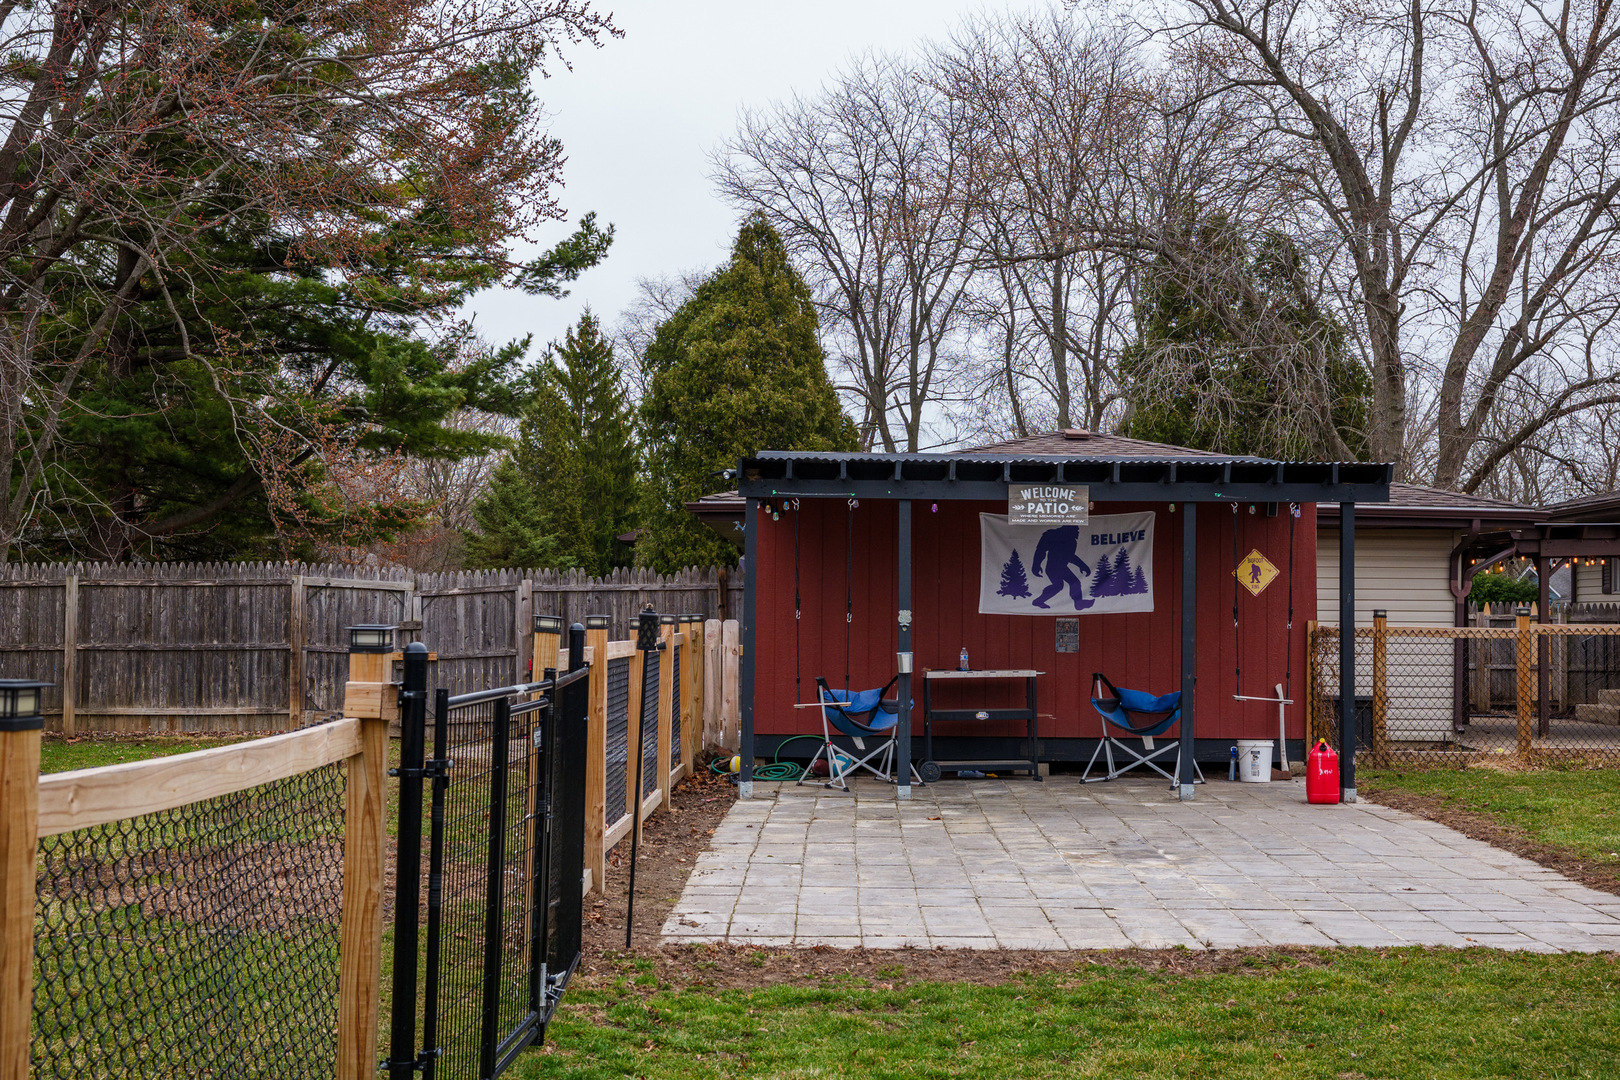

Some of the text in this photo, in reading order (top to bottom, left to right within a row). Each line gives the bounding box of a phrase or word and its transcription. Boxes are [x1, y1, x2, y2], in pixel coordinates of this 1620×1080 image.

[1020, 487, 1076, 502] WELCOME
[1027, 502, 1069, 514] PATIO
[1091, 530, 1145, 545] BELIEVE
